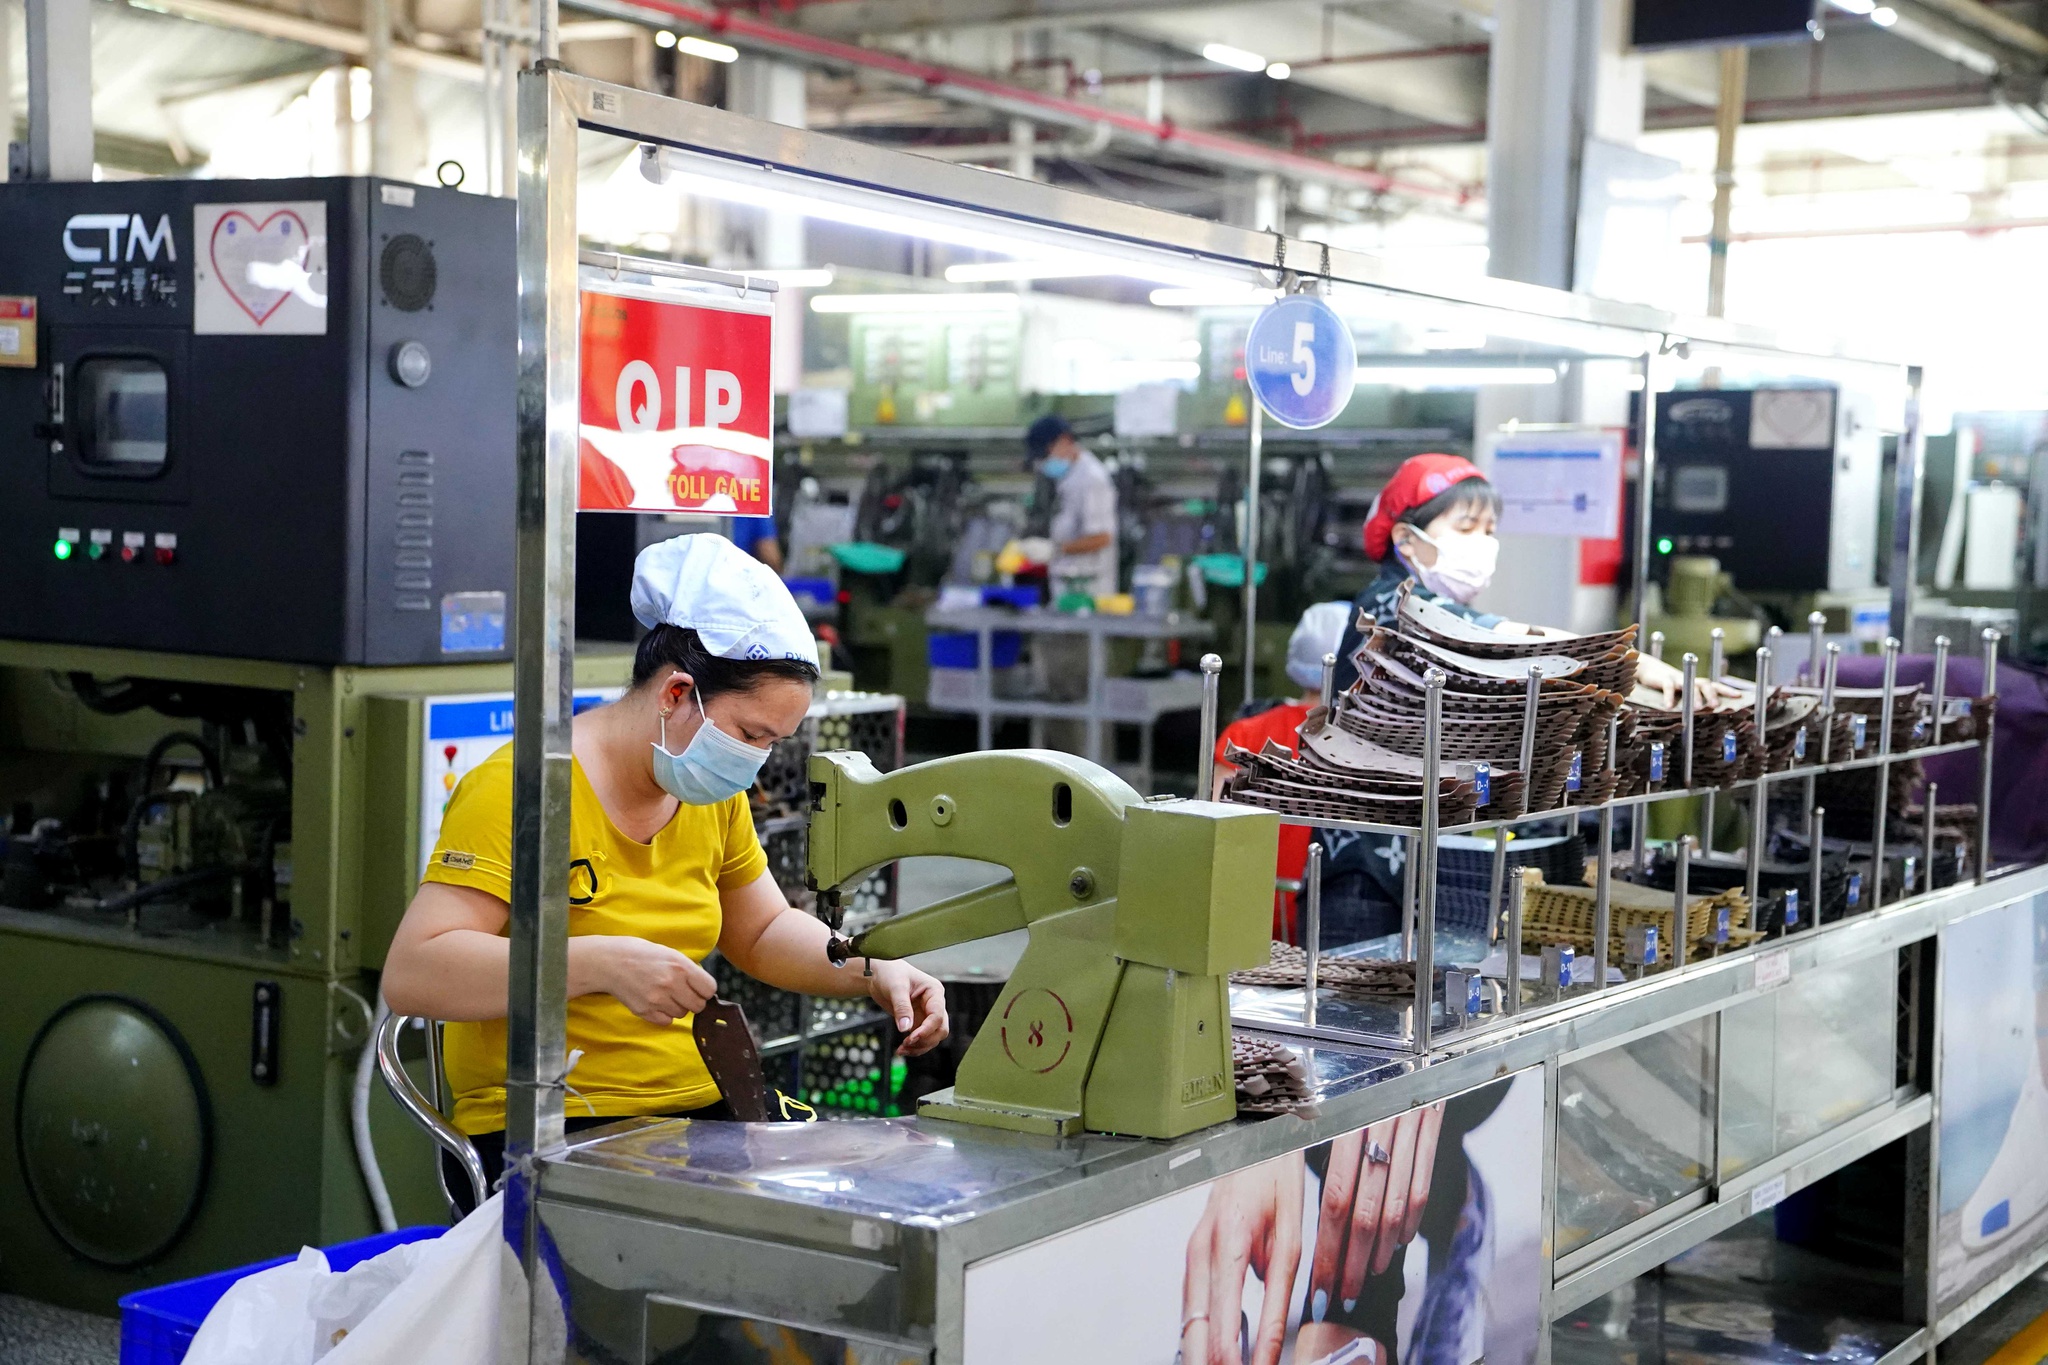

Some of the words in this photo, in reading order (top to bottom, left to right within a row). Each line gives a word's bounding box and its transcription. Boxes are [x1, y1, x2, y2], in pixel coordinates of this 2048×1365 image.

[63, 213, 177, 262] CTM
[1260, 344, 1288, 364] Line:
[1290, 321, 1316, 396] 5
[615, 360, 742, 433] QIP
[667, 474, 709, 500] TOLL
[715, 477, 761, 501] GATE
